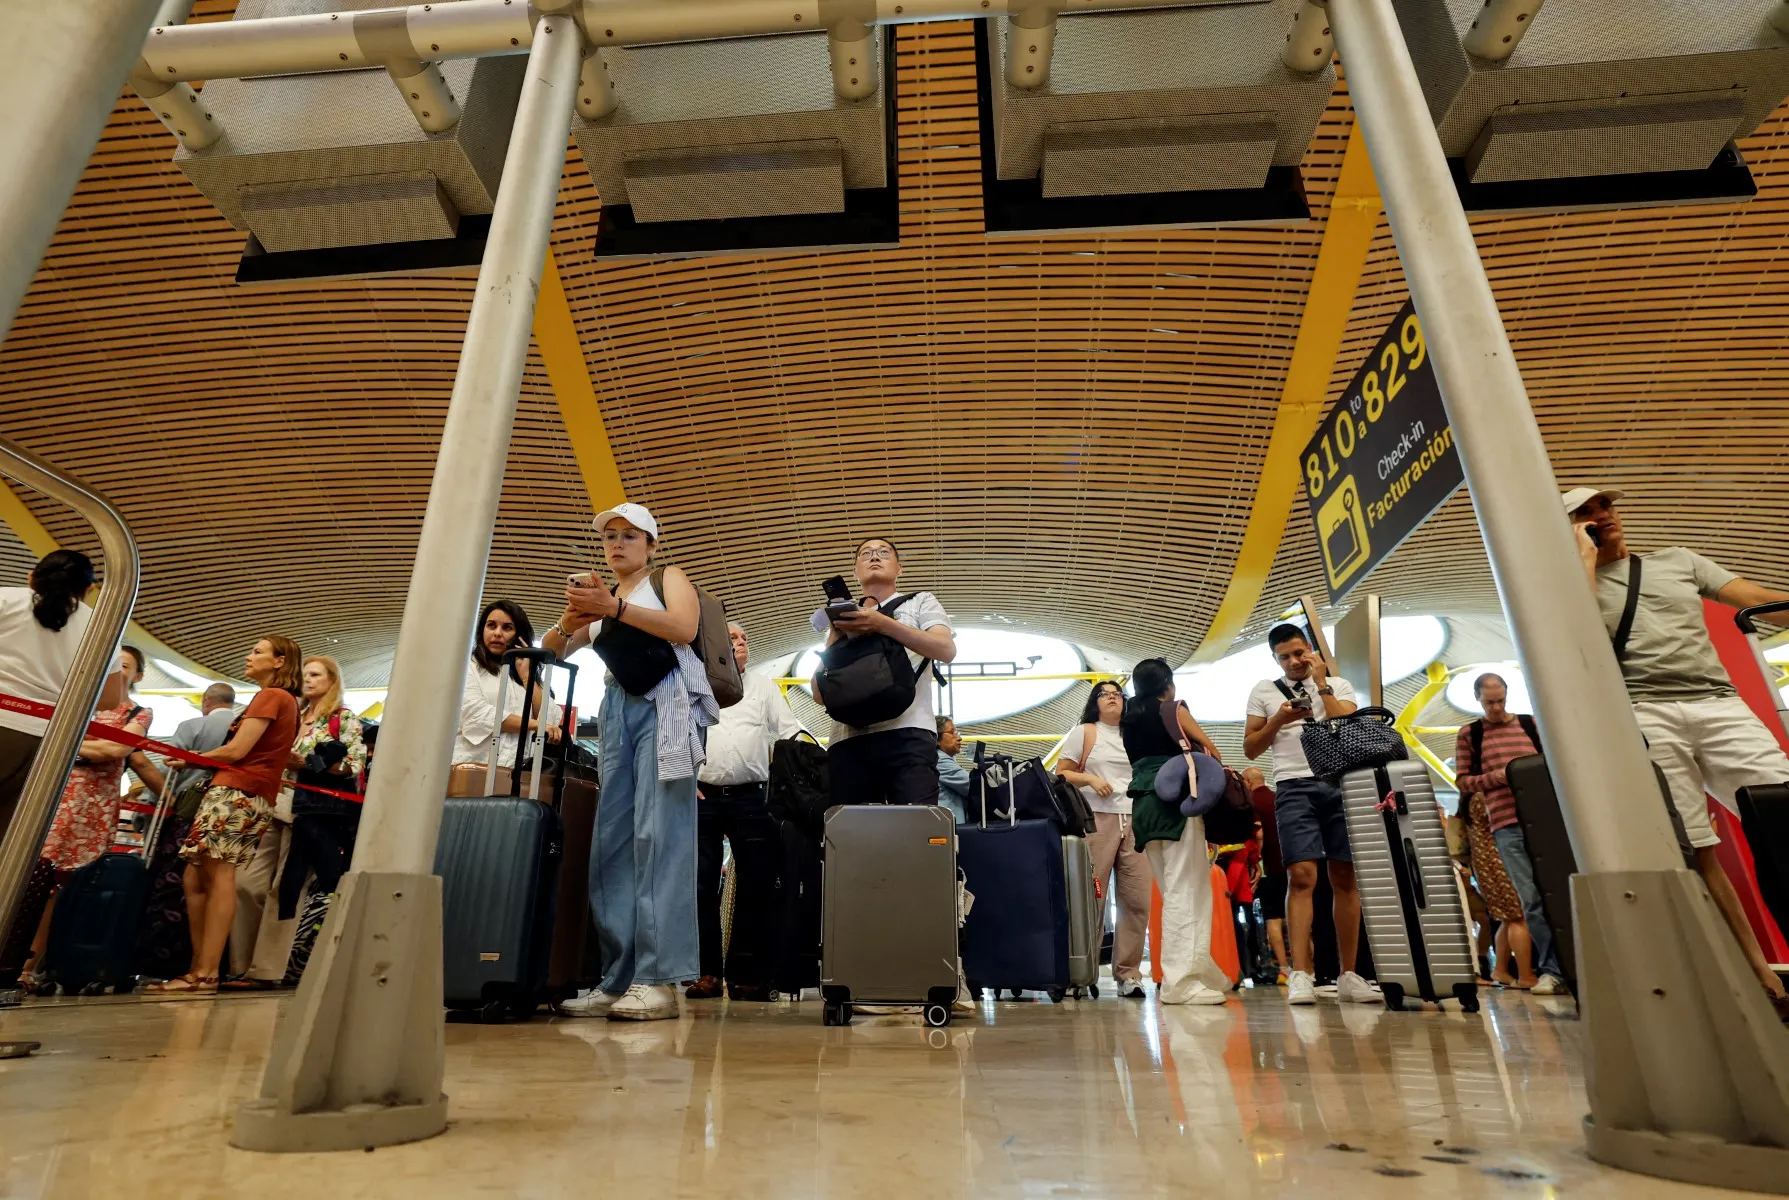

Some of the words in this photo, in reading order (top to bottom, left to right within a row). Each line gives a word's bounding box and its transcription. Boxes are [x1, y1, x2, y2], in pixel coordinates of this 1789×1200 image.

[1362, 313, 1426, 423] 829
[1350, 395, 1362, 415] to
[1358, 420, 1368, 440] a
[1377, 420, 1425, 480] Check-in
[1307, 410, 1355, 498] 810
[1, 699, 32, 711] IBERIA
